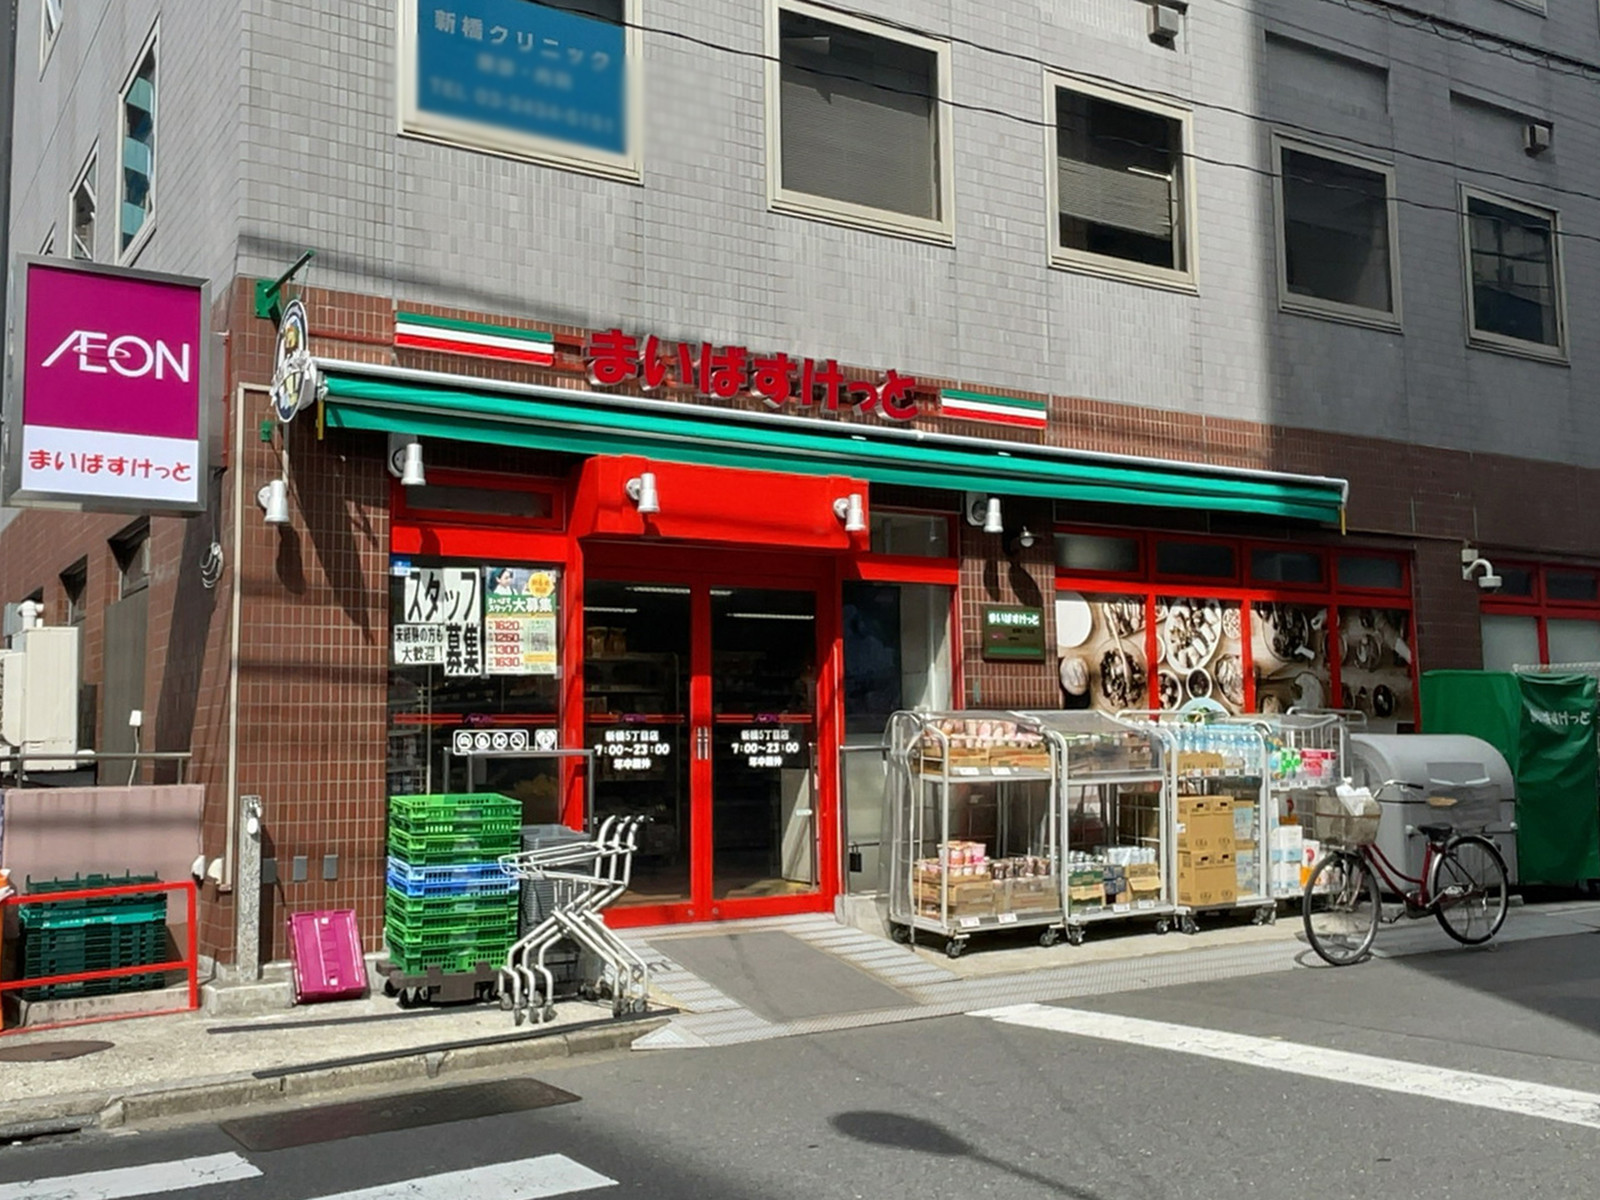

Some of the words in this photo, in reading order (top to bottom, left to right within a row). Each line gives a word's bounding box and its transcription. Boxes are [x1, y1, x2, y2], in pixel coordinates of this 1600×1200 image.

[434, 9, 610, 72] 新橋クリニック
[587, 329, 919, 421] まいばすけっと
[28, 449, 192, 482] まいばすけっと
[408, 571, 477, 621] スタッフ
[395, 627, 444, 643] 未経験の方も
[445, 622, 480, 674] 募集
[494, 644, 520, 655] 1300
